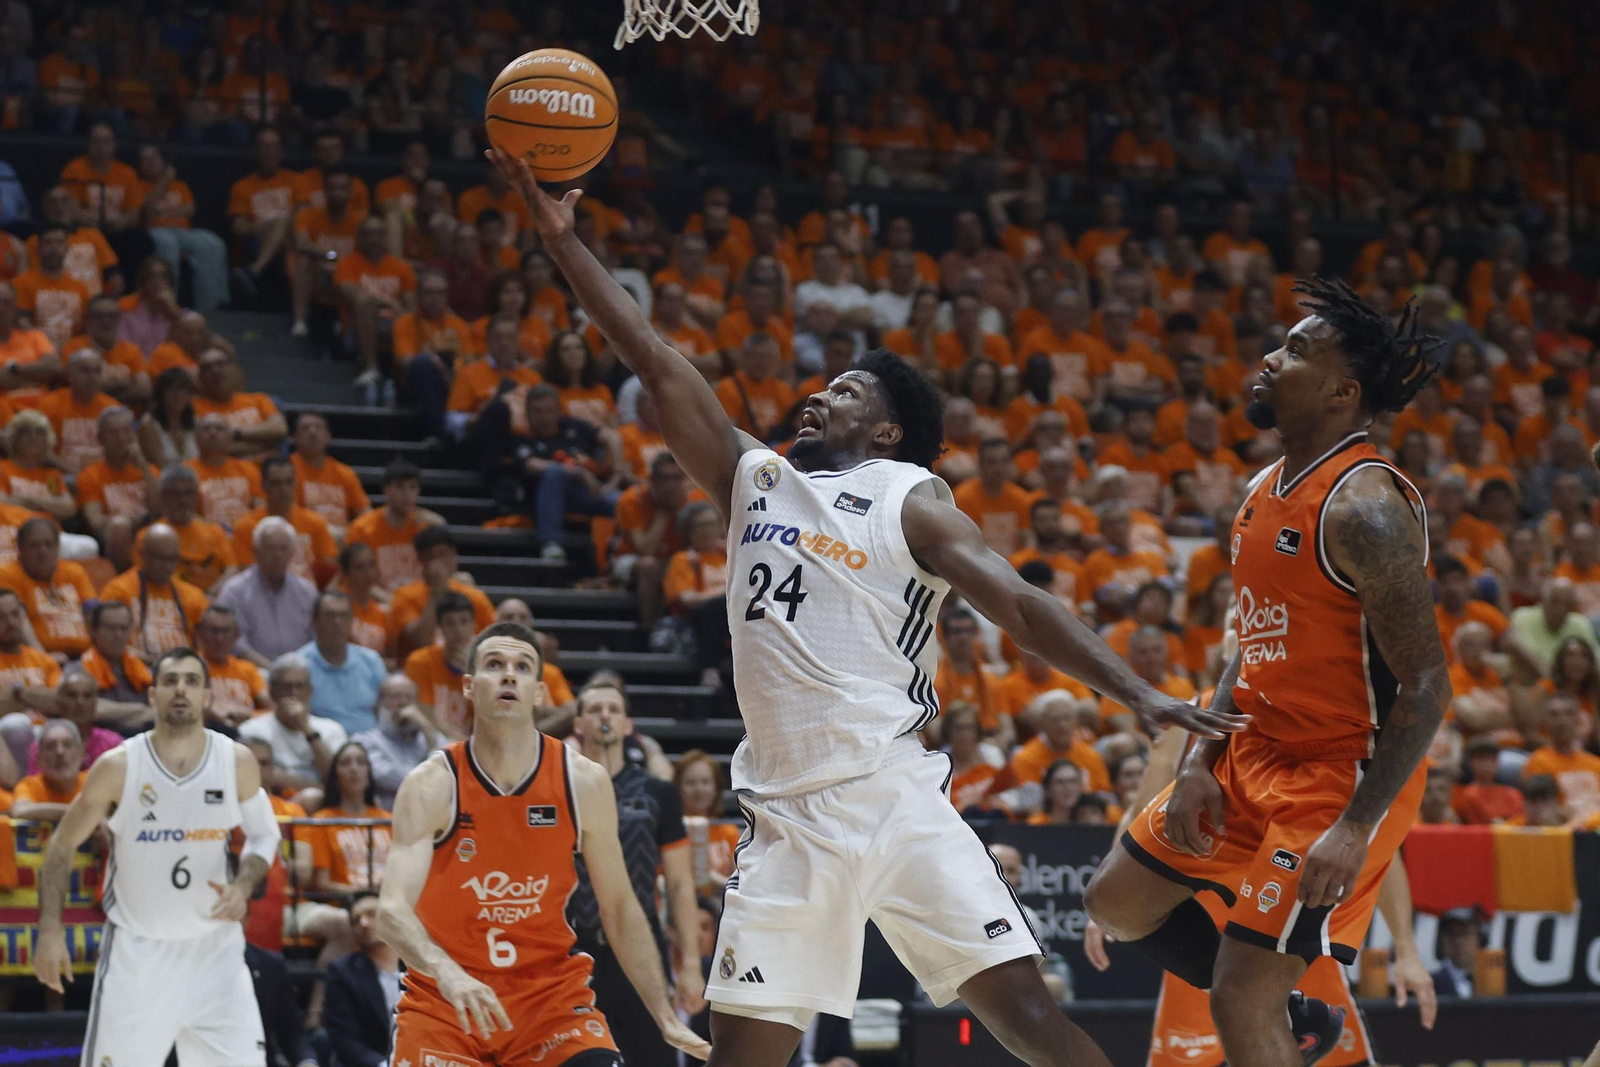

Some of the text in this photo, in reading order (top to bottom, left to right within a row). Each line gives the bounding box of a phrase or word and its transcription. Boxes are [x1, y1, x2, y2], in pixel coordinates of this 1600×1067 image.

[509, 88, 596, 119] Wilson
[836, 502, 866, 514] endesa
[741, 523, 867, 570] AUTOHERO
[745, 562, 808, 622] 24
[1235, 586, 1288, 641] Roig
[136, 829, 227, 842] AUTOHERO
[171, 855, 191, 890] 6
[1274, 856, 1291, 868] acb
[460, 871, 549, 905] Roig
[477, 903, 542, 924] ARENA
[989, 923, 1008, 937] acb
[486, 927, 518, 968] 6
